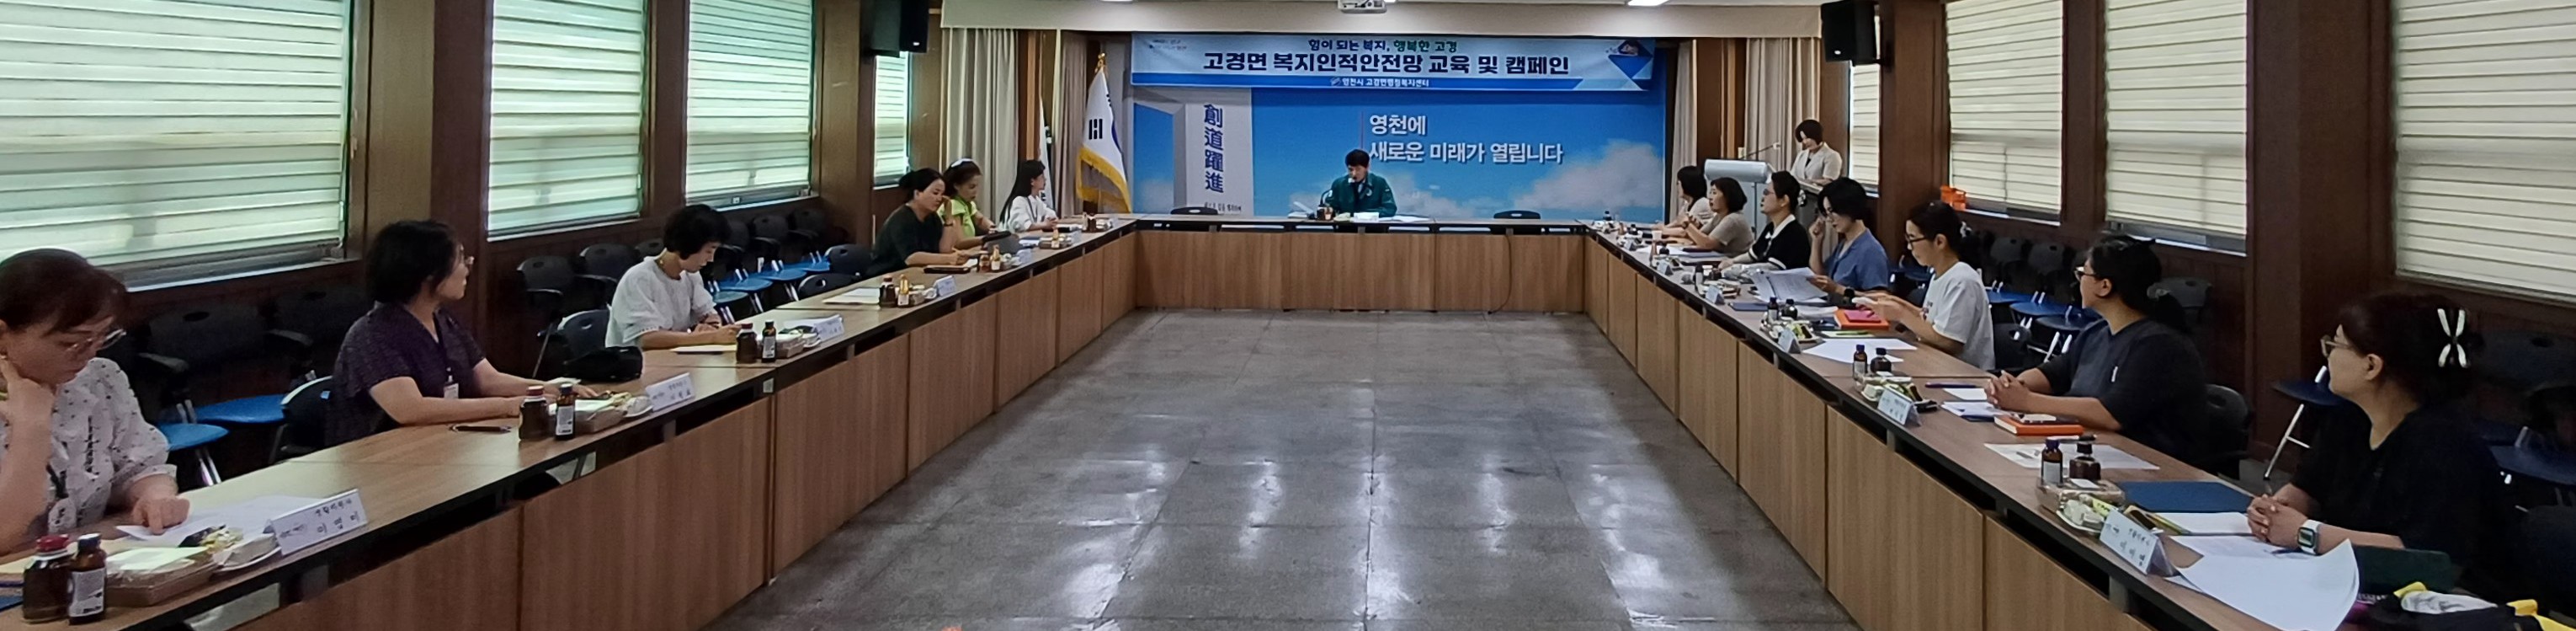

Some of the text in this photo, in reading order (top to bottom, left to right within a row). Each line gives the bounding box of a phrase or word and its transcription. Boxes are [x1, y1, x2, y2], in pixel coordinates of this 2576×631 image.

[1307, 39, 1333, 51] 힘이
[1336, 40, 1360, 51] 되는
[1393, 40, 1430, 51] 행복한
[1434, 40, 1457, 52] 고경
[1204, 53, 1569, 74] 고경면 복지인적안전망 교육 및 캠페인
[1342, 78, 1364, 86] 영천시
[1370, 115, 1426, 135] 영천에
[1204, 104, 1224, 193] 創道躍進
[1369, 142, 1563, 163] 새로운 미래가 열립니다
